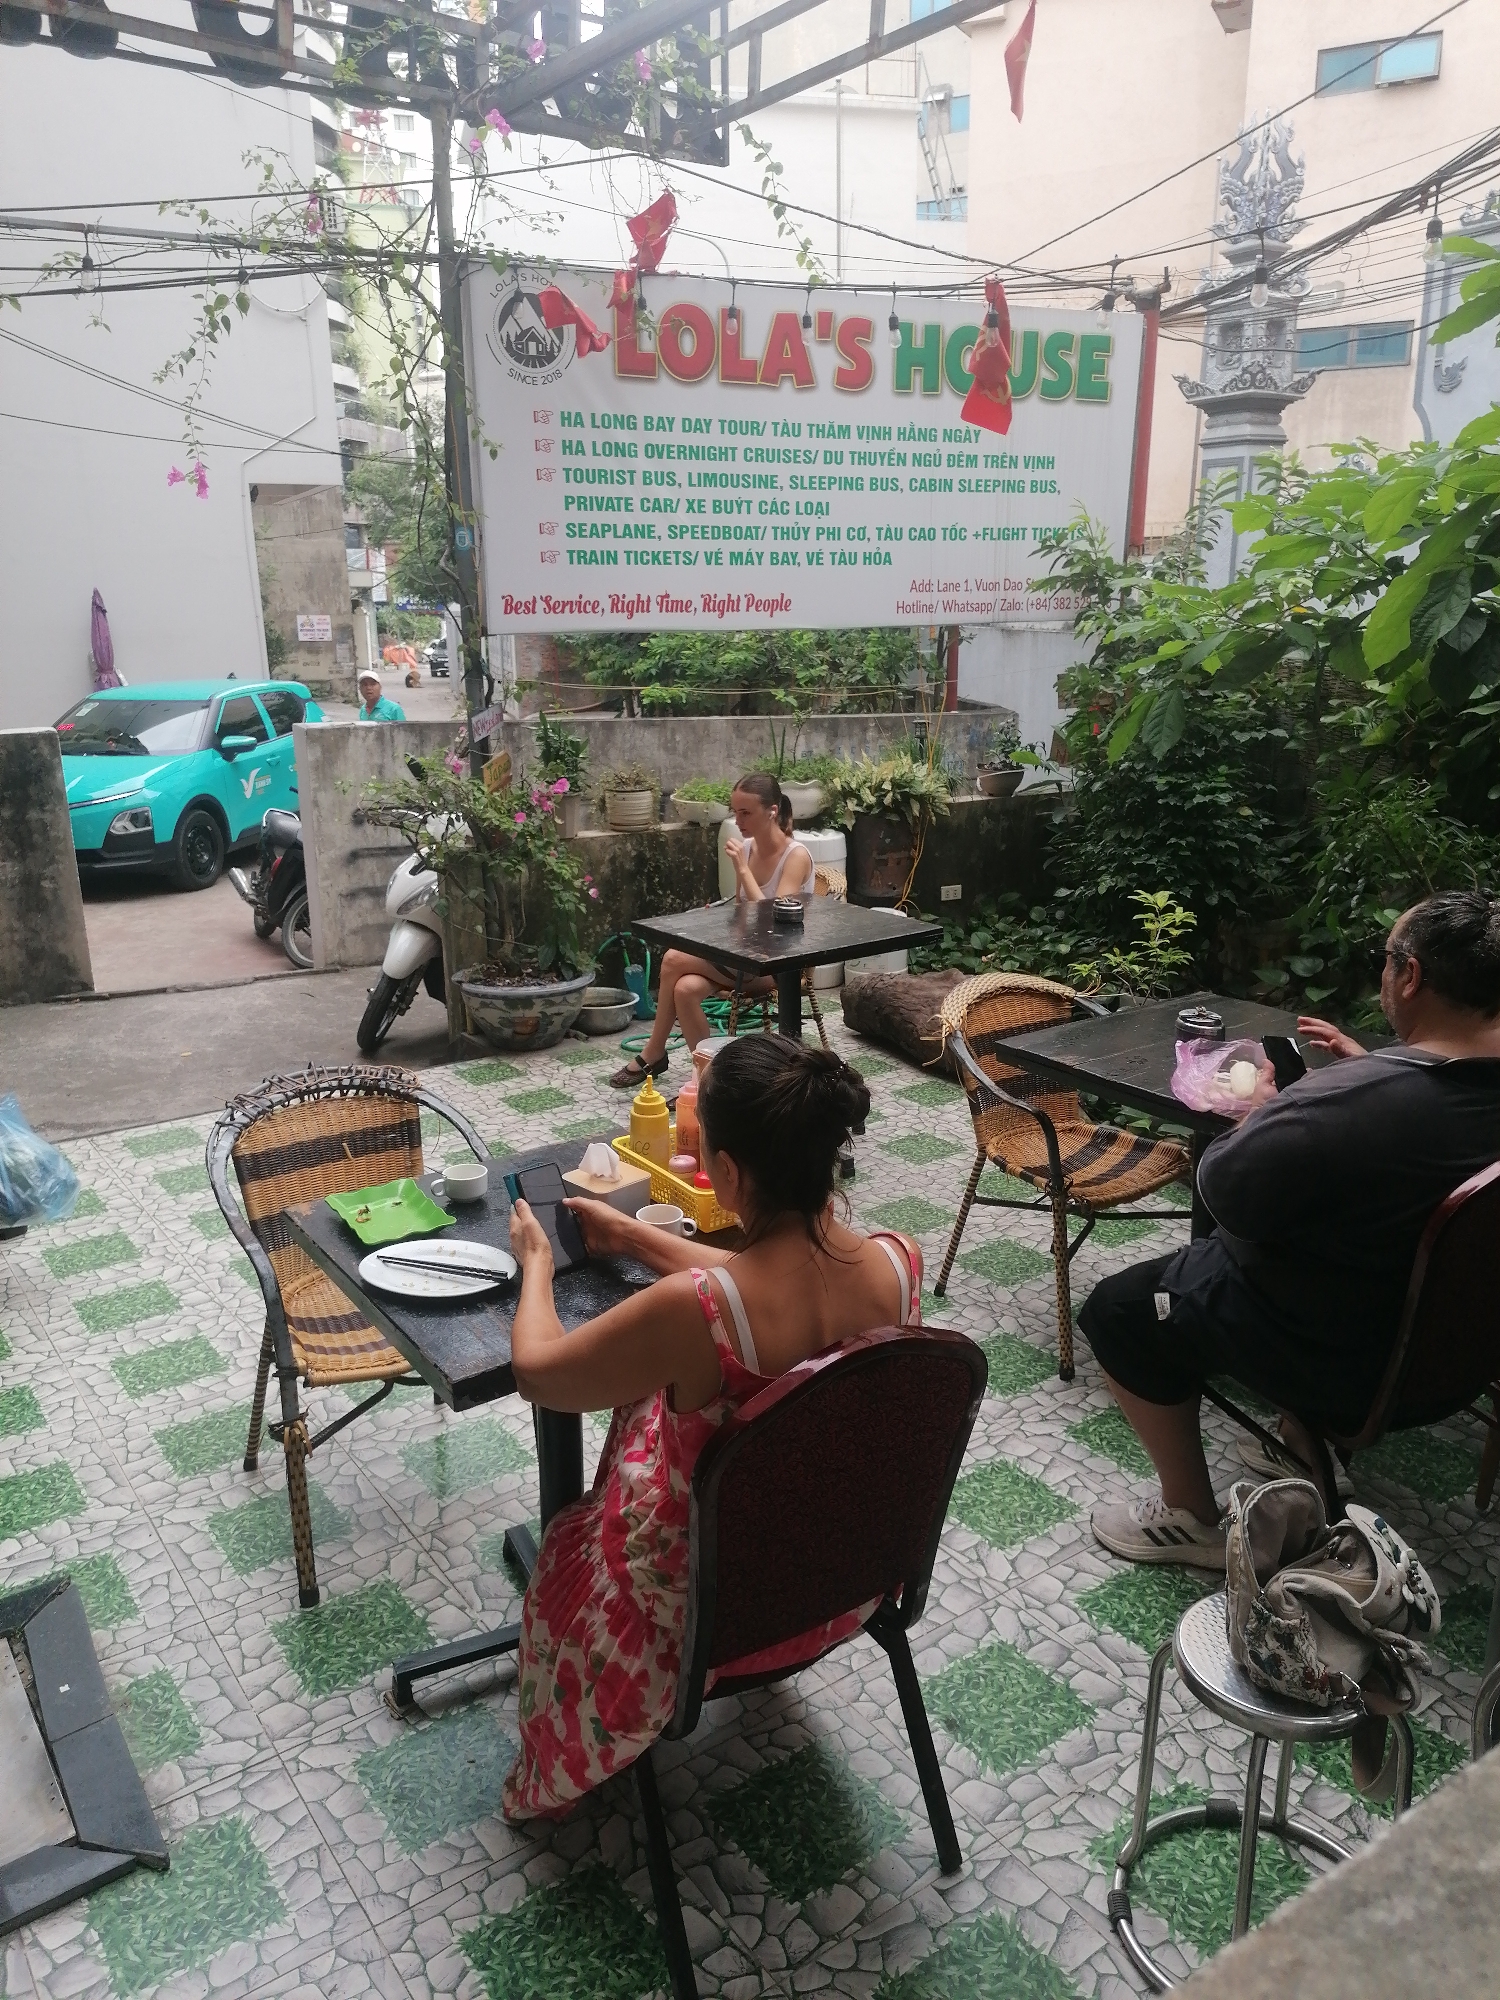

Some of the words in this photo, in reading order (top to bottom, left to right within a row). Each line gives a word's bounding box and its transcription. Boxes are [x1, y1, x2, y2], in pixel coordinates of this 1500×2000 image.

[614, 302, 875, 393] LOLA'S
[507, 367, 539, 386] SINCE
[541, 368, 564, 386] 2018
[560, 410, 584, 428] HA
[590, 412, 637, 431] LONG
[643, 415, 675, 432] BAY
[681, 417, 712, 434] DAY
[719, 418, 766, 437] TOUR/
[772, 419, 802, 438] TÀU
[808, 421, 851, 439] THĂM
[856, 425, 892, 443] VỊNH
[897, 422, 938, 443] HẰNG
[942, 426, 981, 444] NGÀY
[561, 439, 586, 456] HA
[591, 441, 638, 459] LONG
[644, 442, 737, 462] OVERNIGHT
[743, 446, 818, 465] CRUISES/
[822, 449, 844, 466] DU
[849, 447, 907, 467] THUYỀN
[911, 450, 942, 468] NGỦ
[946, 451, 978, 469] ĐÊM
[983, 452, 1018, 469] TRÊN
[1023, 455, 1055, 472] VỊNH
[563, 467, 635, 486] TOURIST
[641, 469, 681, 487] BUS,
[687, 472, 784, 491] LIMOUSINE,
[789, 474, 864, 492] SLEEPING
[868, 476, 903, 494] BUS,
[908, 477, 953, 493] CABIN
[958, 478, 1025, 494] SLEEPING
[1029, 479, 1061, 496] BUS,
[564, 495, 633, 513] PRIVATE
[639, 497, 680, 514] CAR/
[685, 498, 705, 514] XE
[711, 497, 752, 515] BUÝT
[757, 497, 790, 516] CÁC
[794, 500, 830, 520] LOẠI
[565, 522, 661, 540] SEAPLANE,
[667, 524, 767, 541] SPEEDBOAT/
[772, 521, 810, 541] THỦY
[815, 525, 841, 541] PHI
[845, 526, 871, 544] CƠ,
[876, 524, 903, 542] TÀU
[907, 526, 937, 542] CAO
[942, 524, 967, 542] TỐC
[971, 526, 1028, 541] +FLIGHT
[567, 549, 618, 566] TRAIN
[624, 549, 699, 566] TICKETS/
[703, 548, 723, 566] VÉ
[728, 549, 764, 566] MÁY
[769, 551, 801, 567] BAY,
[805, 550, 823, 566] VÉ
[830, 550, 858, 566] TÀU
[862, 547, 892, 566] HỎA
[910, 578, 934, 594] Add:
[937, 578, 961, 593] Lane
[965, 578, 974, 595] 1,
[975, 577, 1001, 592] Vuon
[1004, 578, 1023, 592] Dao
[502, 593, 537, 616] Best
[540, 593, 605, 617] Service,
[608, 593, 651, 621] Right
[655, 591, 697, 614] Time,
[700, 593, 741, 620] Right
[744, 592, 792, 618] People
[897, 599, 939, 614] Hotline/
[942, 598, 998, 616] Whatsapp/
[1000, 598, 1024, 612] Zalo:
[1026, 597, 1051, 613] (+84)
[1053, 597, 1071, 610] 382
